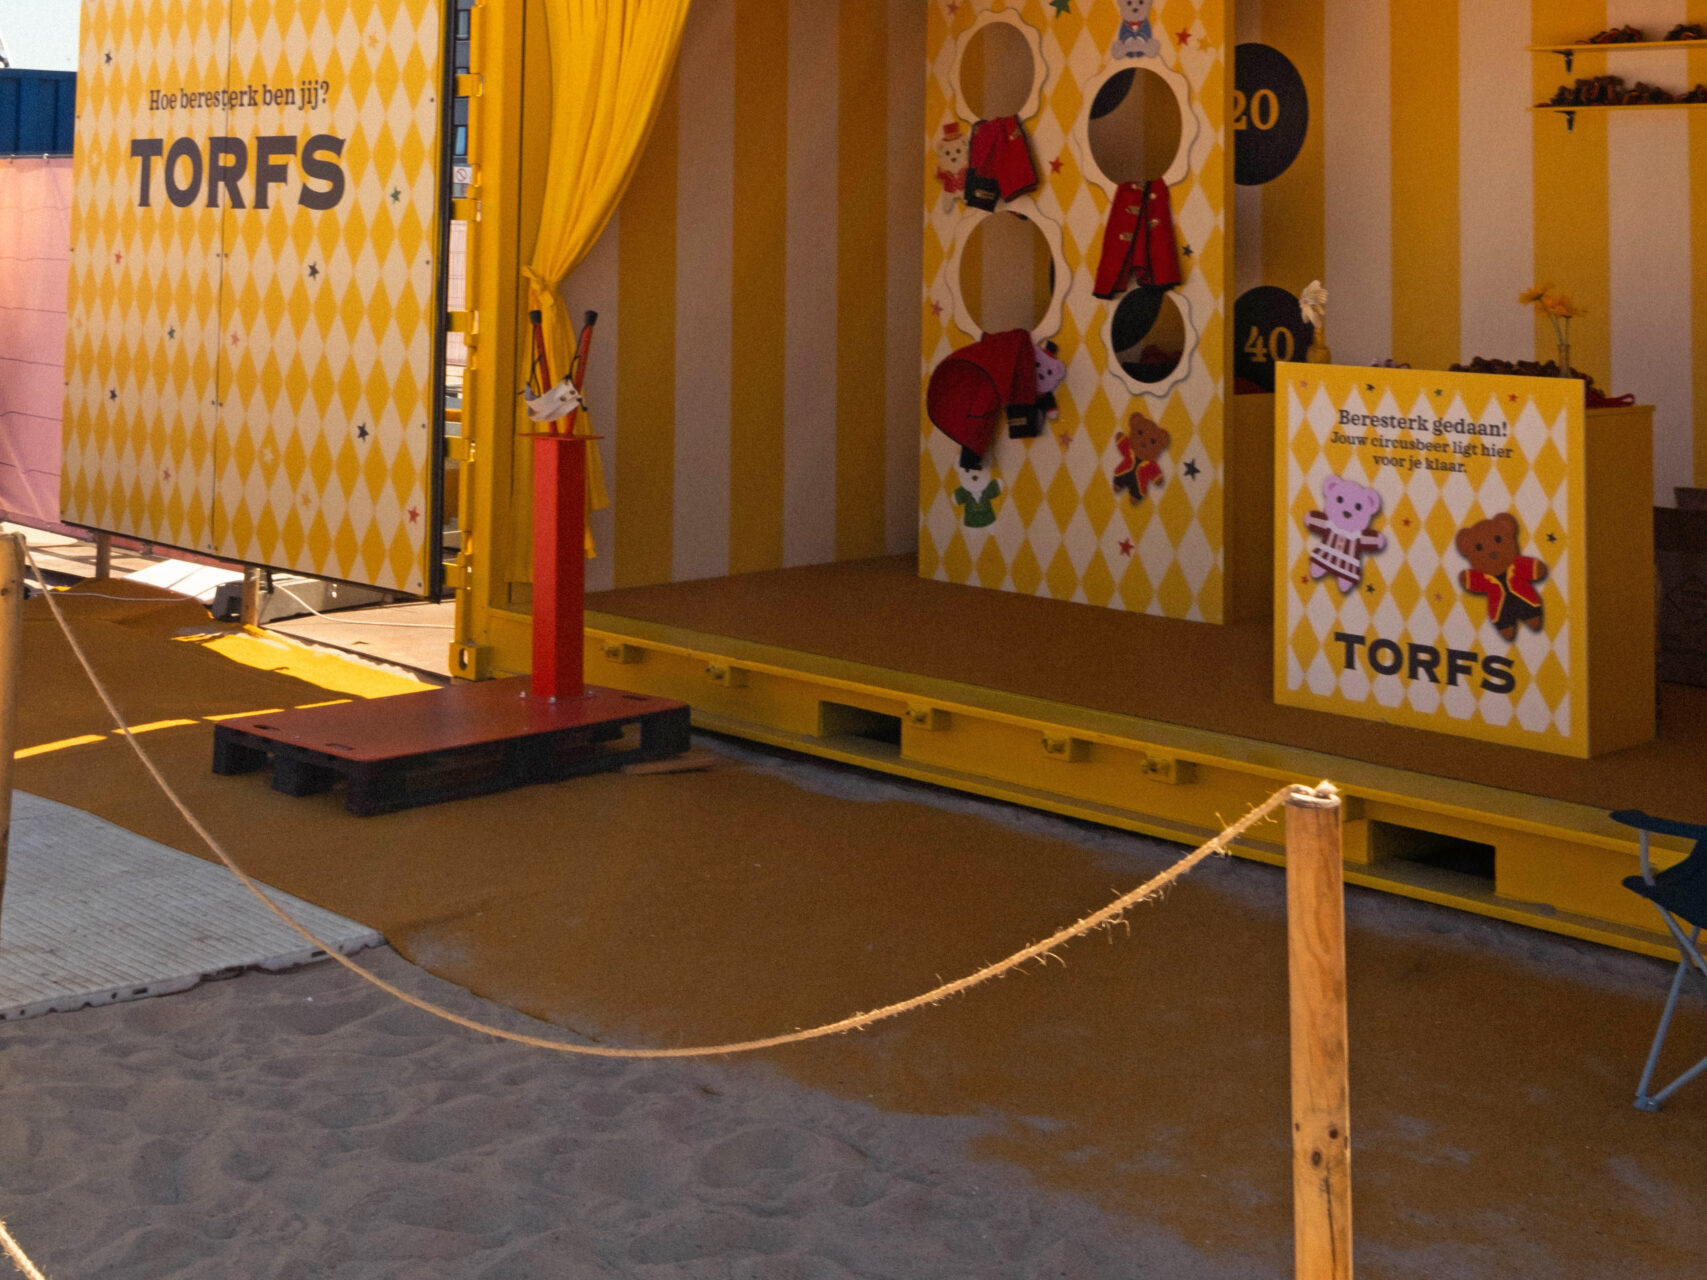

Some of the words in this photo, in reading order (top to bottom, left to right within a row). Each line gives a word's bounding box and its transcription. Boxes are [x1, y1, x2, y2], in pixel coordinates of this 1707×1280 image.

[149, 89, 177, 111] Hoe
[180, 85, 258, 111] beresterk
[262, 84, 296, 107] ben
[298, 80, 330, 111] jij?
[131, 134, 346, 210] TORFS
[1244, 325, 1295, 362] 40
[1338, 409, 1429, 432] Beresterk
[1432, 418, 1508, 437] gedaan!
[1330, 431, 1368, 446] Jouw
[1371, 435, 1450, 454] circusbeer
[1453, 441, 1478, 458] ligt
[1481, 443, 1513, 459] hier
[1373, 454, 1406, 467] voor
[1408, 455, 1422, 471] je
[1425, 457, 1467, 473] klaar.
[1334, 631, 1517, 694] TORFS
